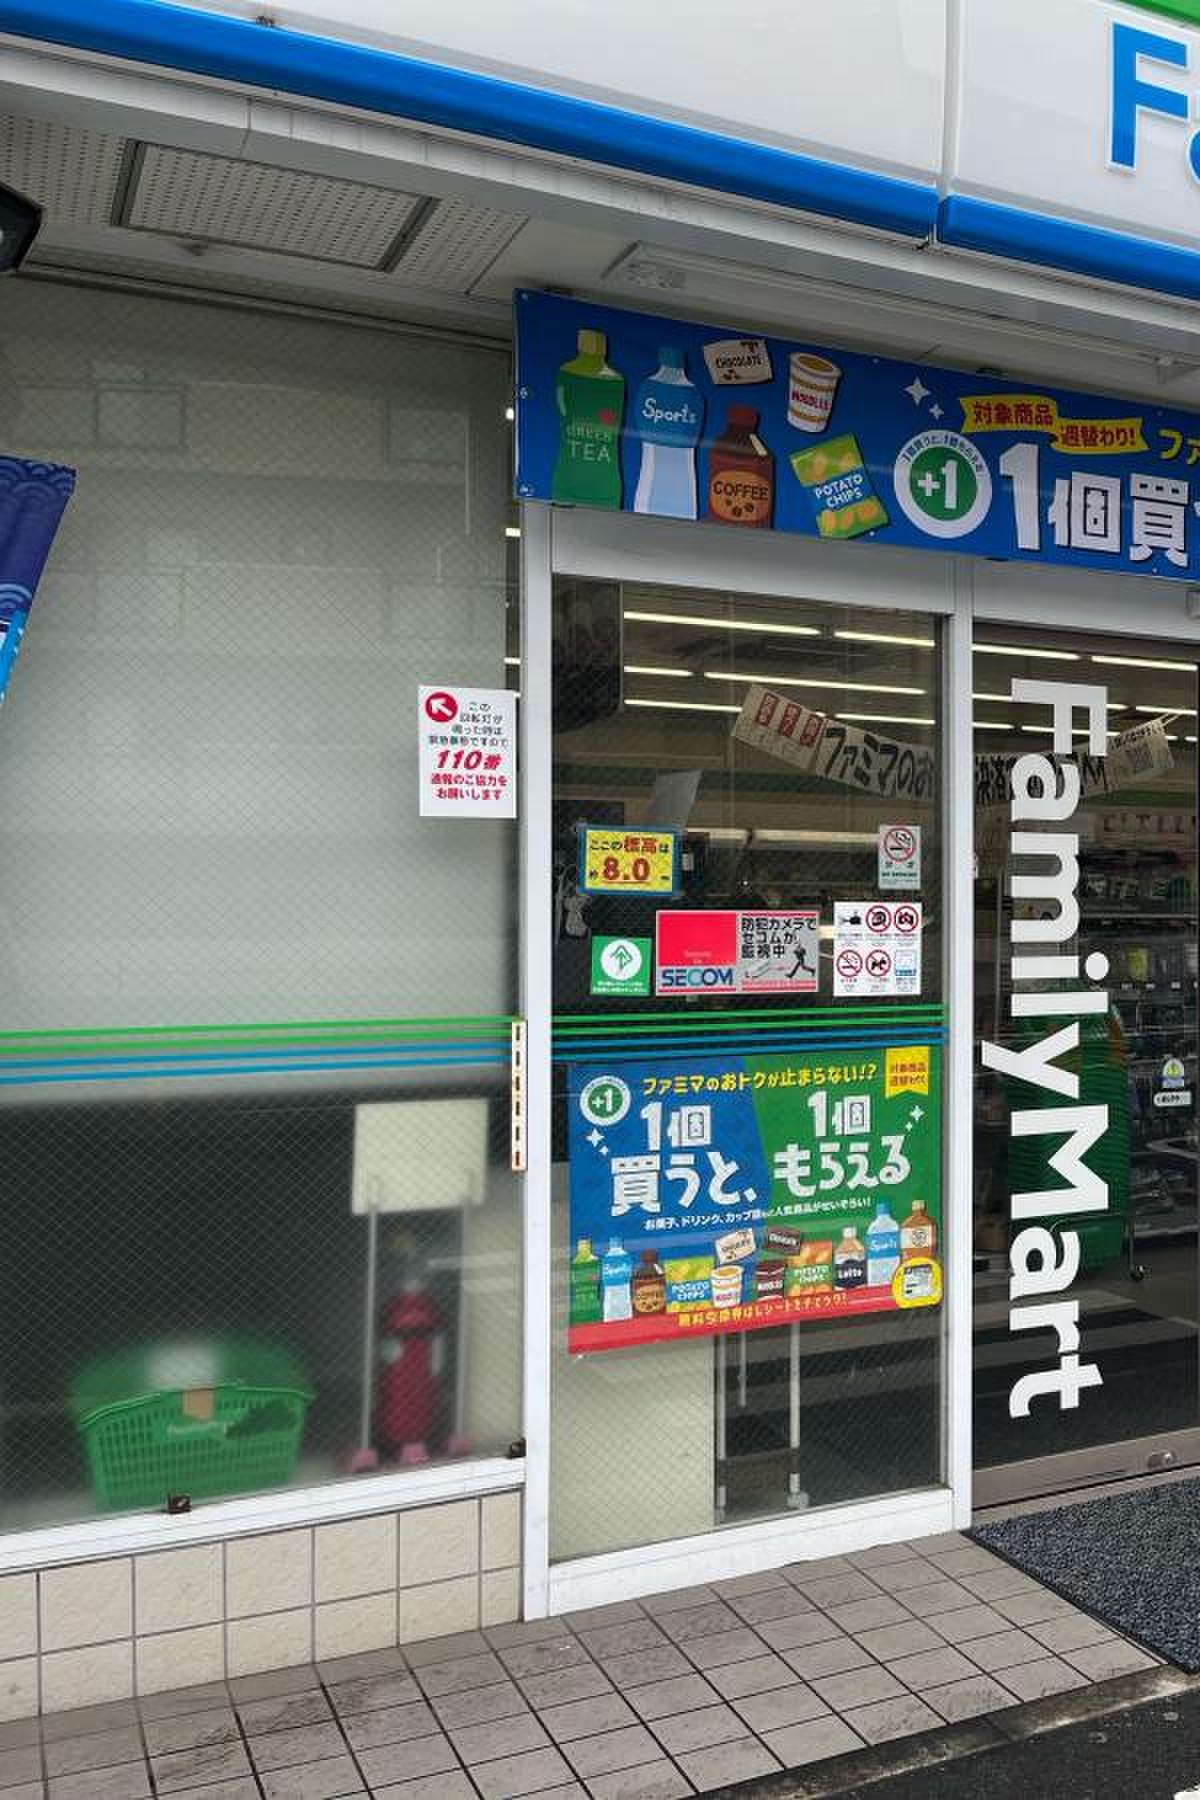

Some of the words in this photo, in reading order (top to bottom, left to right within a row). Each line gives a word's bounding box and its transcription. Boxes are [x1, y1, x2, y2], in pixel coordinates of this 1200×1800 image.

[641, 397, 697, 424] Sports
[972, 401, 1054, 426] 対象商品
[566, 441, 613, 463] TEA
[713, 480, 769, 500] COFFEE
[814, 473, 864, 499] POTATO
[825, 487, 864, 508] CHIPS
[469, 701, 491, 712] この
[436, 749, 503, 770] 110番
[437, 787, 503, 800] お願いします
[602, 855, 651, 882] 8.0
[741, 917, 817, 931] 防犯カメラで
[741, 930, 798, 945] セコムが
[741, 944, 786, 959] 監視中
[661, 967, 734, 988] SECOM
[980, 677, 1109, 1419] FamilyMart
[807, 1090, 871, 1137] 1個
[640, 1101, 712, 1151] 1個
[773, 1135, 912, 1198] もらえる
